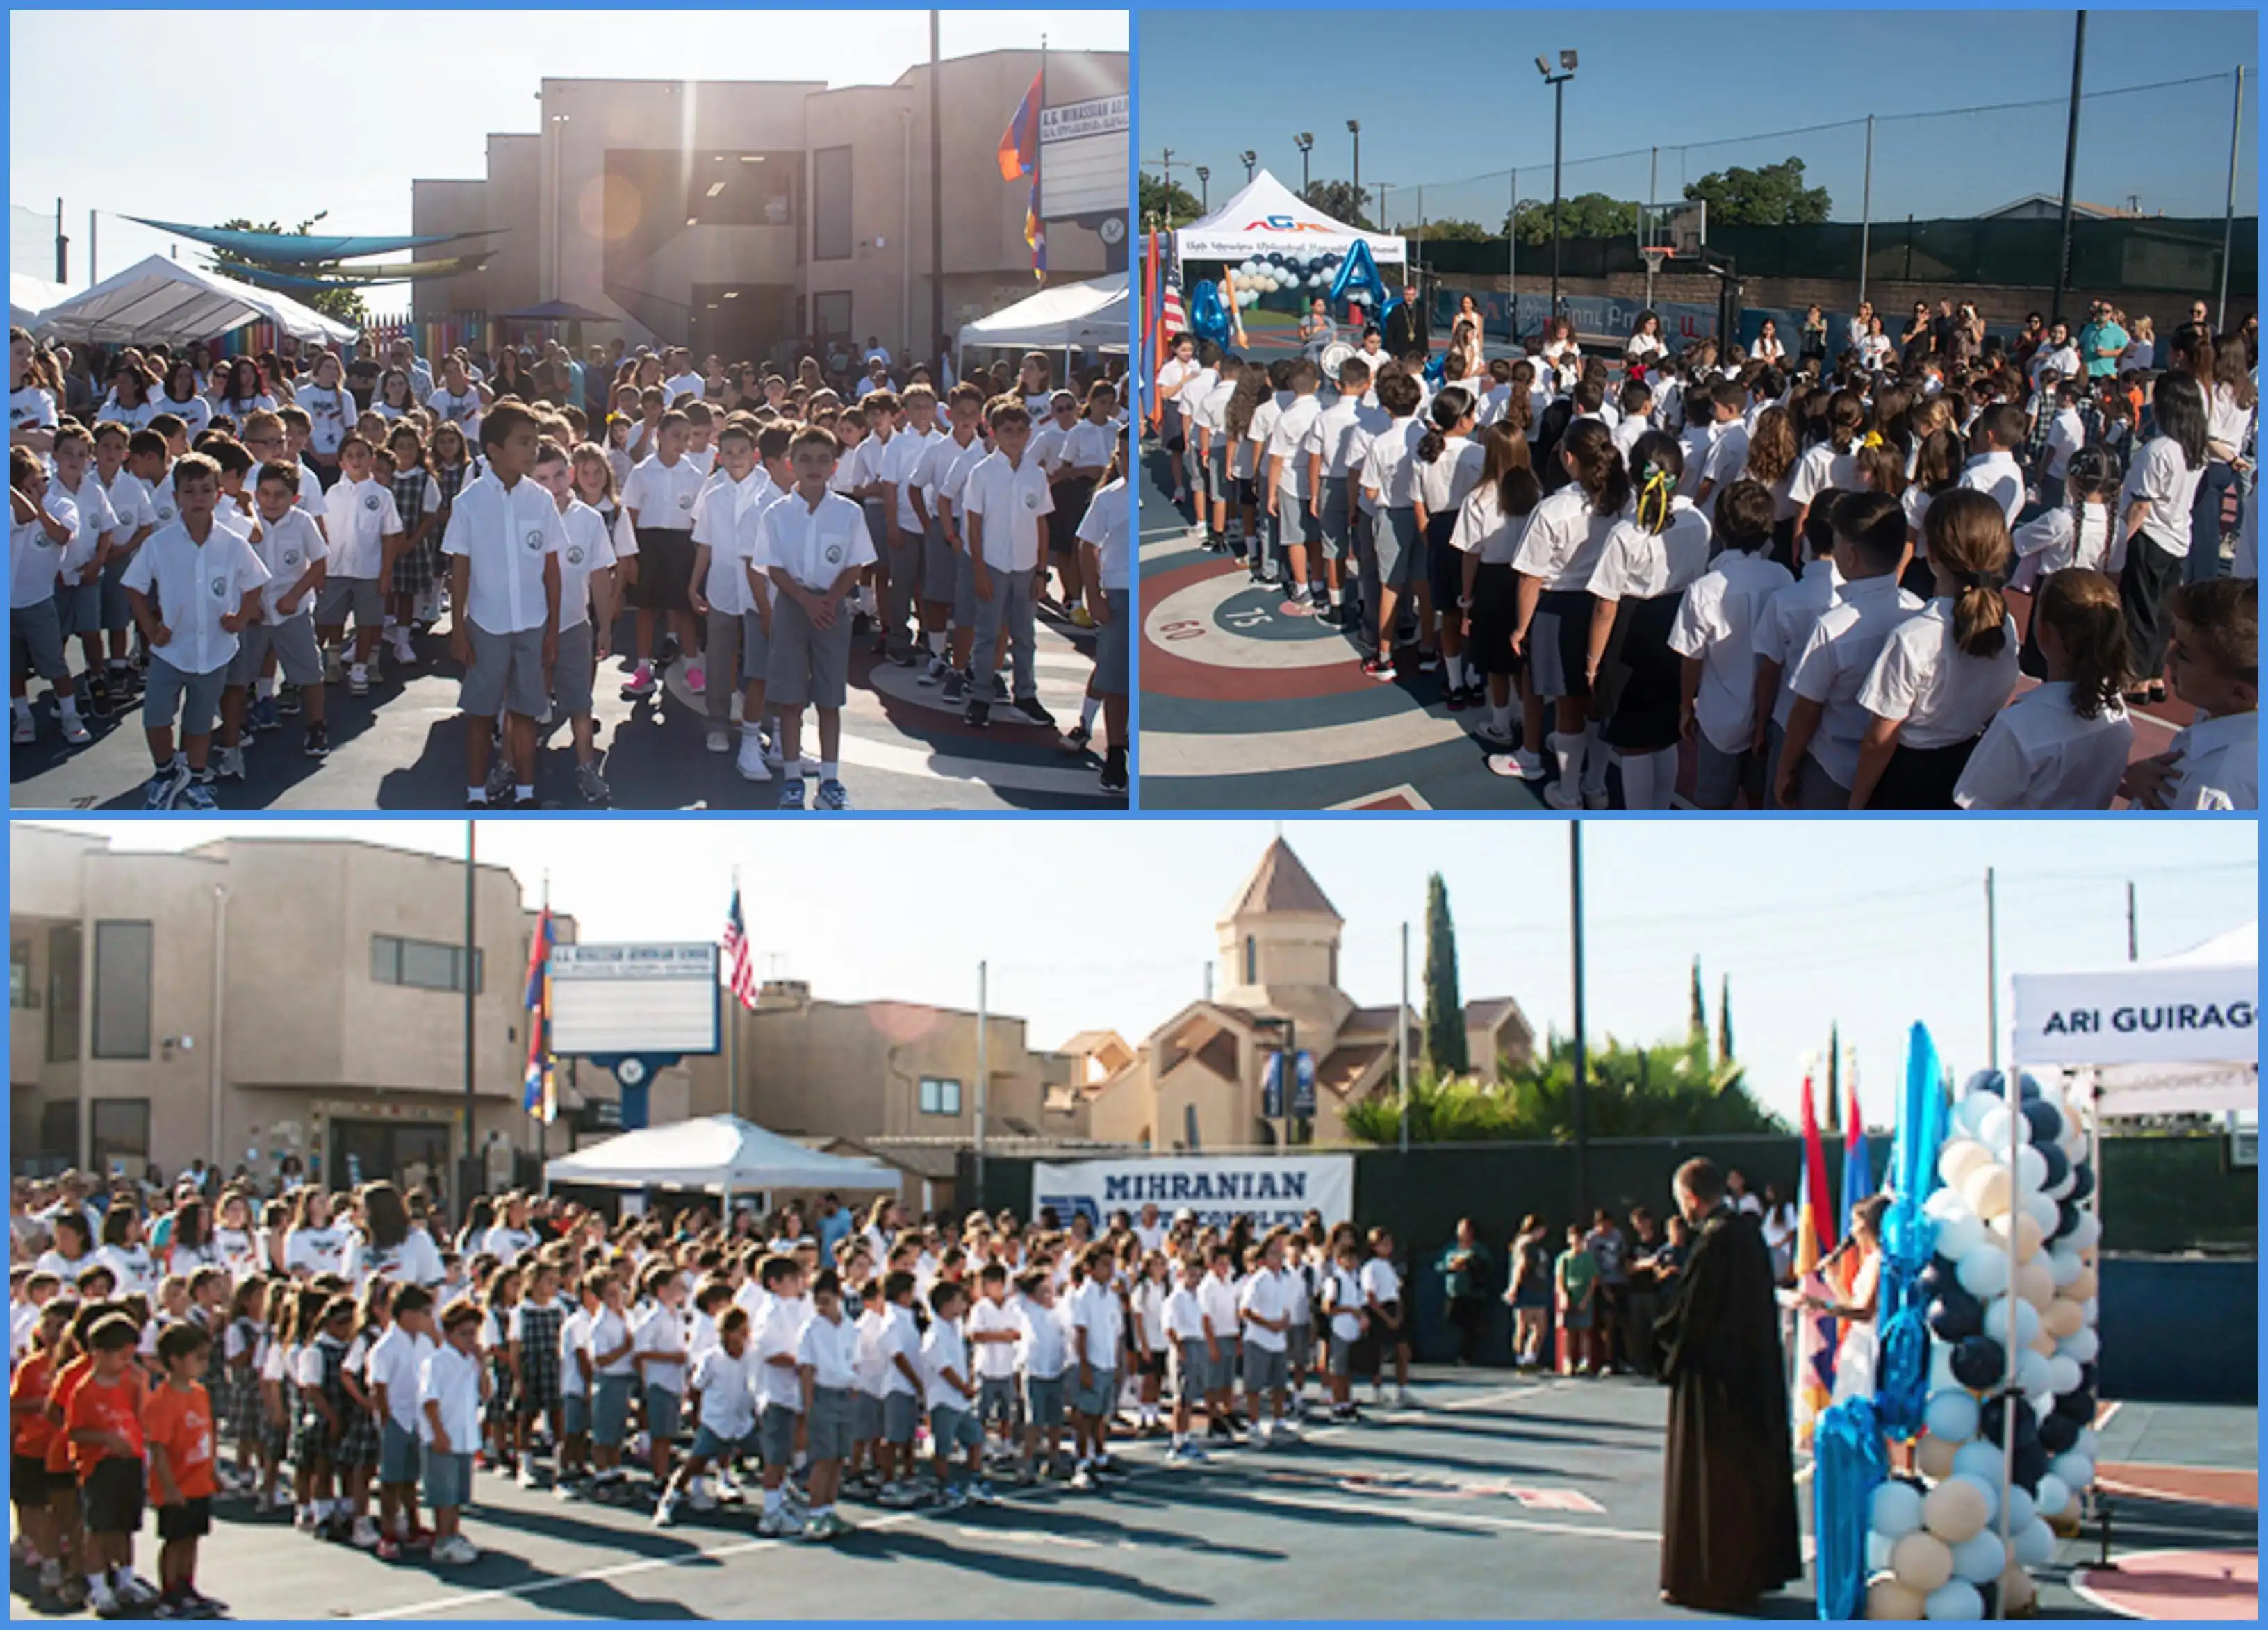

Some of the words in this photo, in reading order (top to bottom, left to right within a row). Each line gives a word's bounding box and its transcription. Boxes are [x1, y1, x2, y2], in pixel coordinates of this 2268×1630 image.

[1160, 620, 1206, 641] 60
[2043, 1009, 2100, 1035] ARI
[2112, 1001, 2258, 1033] GUIRAG
[1104, 1171, 1307, 1201] MIHRANIAN
